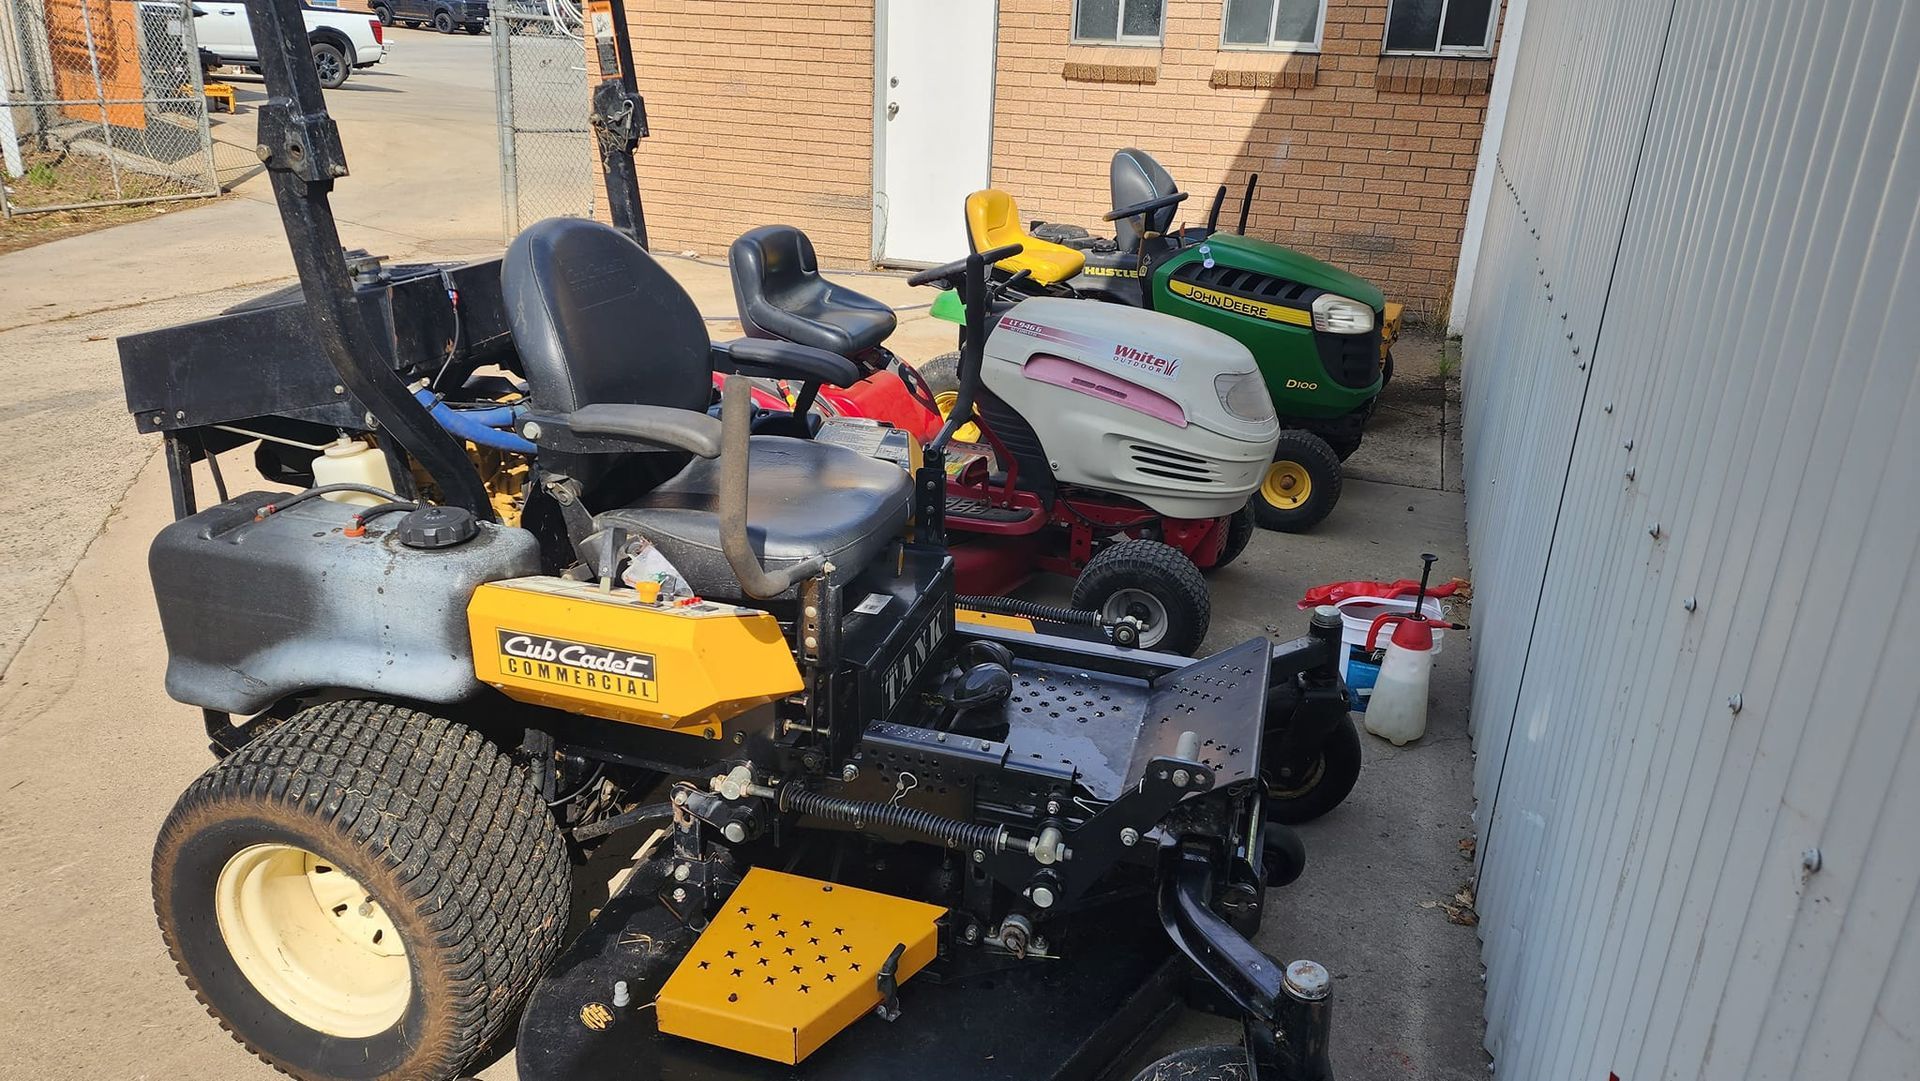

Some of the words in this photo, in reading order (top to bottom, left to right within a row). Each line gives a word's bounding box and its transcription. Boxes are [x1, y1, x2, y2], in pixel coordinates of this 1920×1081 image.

[1186, 286, 1222, 306] JOHN
[1223, 296, 1268, 318] DEERE
[1113, 356, 1162, 374] OUTDOOR
[1114, 344, 1167, 368] White
[1286, 379, 1318, 390] D100
[504, 636, 557, 662] Cub
[885, 609, 943, 710] TANK
[508, 658, 650, 697] COMMERCIAL
